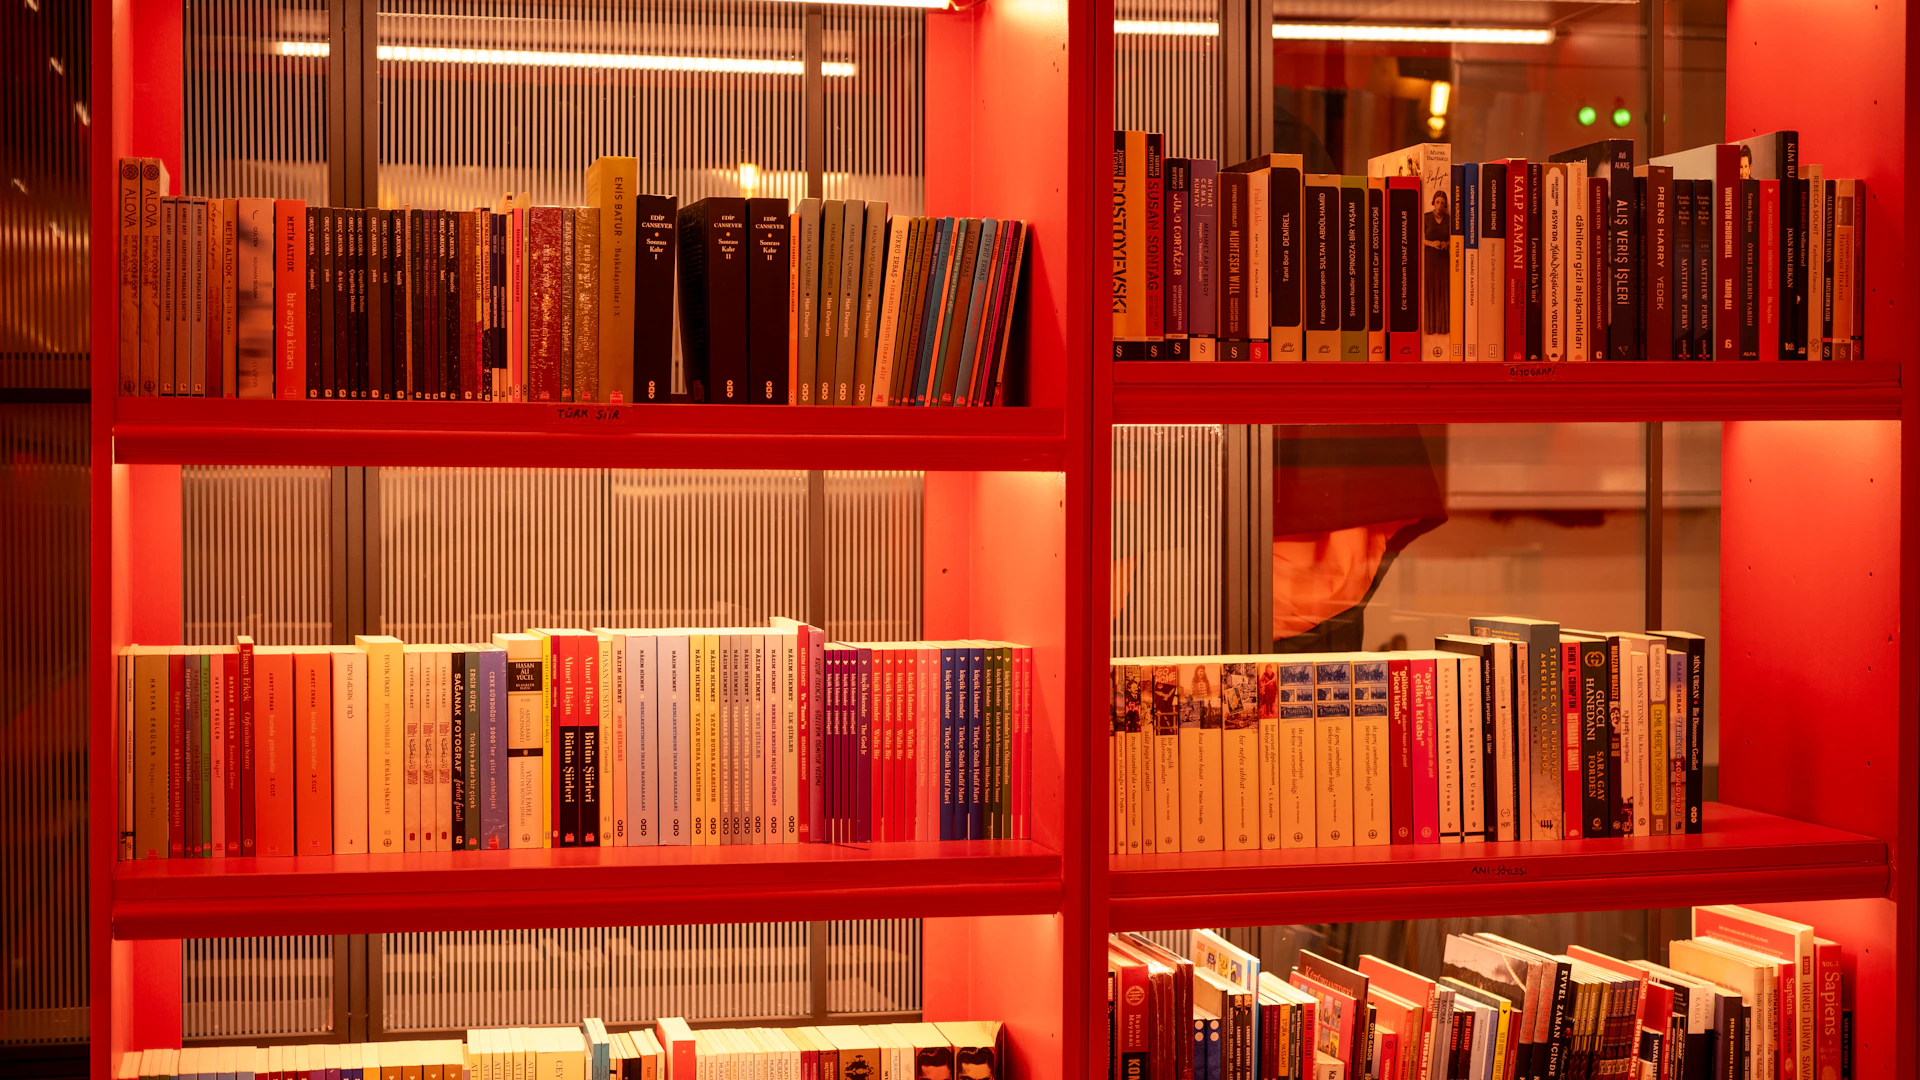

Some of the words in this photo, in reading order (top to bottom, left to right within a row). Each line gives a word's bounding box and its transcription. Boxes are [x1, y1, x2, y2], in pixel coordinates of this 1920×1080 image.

[615, 177, 625, 200] ENİS
[1514, 176, 1523, 210] KALP
[124, 189, 136, 228] ALOVA
[145, 189, 157, 228] ALOVA
[614, 204, 622, 236] BATUR
[1147, 181, 1159, 231] SUSAN
[1318, 193, 1326, 240] ABDÜLHAMİD
[1615, 200, 1628, 225] ALIŞ
[287, 216, 295, 241] METİN
[893, 230, 902, 253] ŞÜKRÜ
[1514, 215, 1523, 269] ZAMANI
[1576, 215, 1584, 260] dâhilerin
[1147, 235, 1159, 290] SONTAG
[1173, 226, 1183, 275] CORTÁZAR
[1228, 230, 1239, 273] MUHTEŞEM
[1615, 231, 1629, 263] VERİŞ
[613, 248, 621, 303] Başkalaşımlar
[890, 256, 899, 277] ERBAŞ
[1574, 263, 1584, 283] gizli
[1745, 266, 1753, 300] ŞEYLERİN
[287, 293, 296, 307] bir
[887, 284, 896, 313] insanın
[1230, 276, 1239, 295] WILL
[1615, 268, 1630, 305] İŞLERİ
[1724, 279, 1732, 297] TARIQ
[284, 310, 295, 336] acıya
[1574, 286, 1584, 349] alışkanlıkları
[287, 339, 296, 369] kiracı
[558, 408, 588, 418] TÜRK
[585, 655, 593, 685] Ahmet
[1156, 667, 1169, 675] GO
[1568, 647, 1576, 666] HENRY
[1693, 655, 1701, 673] MİNA
[243, 678, 251, 701] Erkek
[872, 672, 880, 692] küçük
[1156, 672, 1175, 683] HOME
[1413, 673, 1423, 707] çelikel
[1540, 654, 1548, 700] AMERİKA
[454, 673, 462, 715] SAĞANAK
[873, 694, 881, 721] İskender
[1586, 678, 1595, 741] HANEDANI
[1596, 690, 1605, 727] GUCCI
[454, 720, 462, 771] FOTOĞRAF
[565, 732, 574, 763] Bütün
[585, 732, 594, 764] Bütün
[1550, 730, 1558, 780] RUHUYLA
[563, 766, 574, 802] Şiirleri
[583, 766, 594, 802] Şiirleri
[1588, 755, 1596, 797] FORDEN
[1558, 970, 1568, 1001] EVVEL
[1784, 978, 1794, 1015] Sapiens
[1694, 997, 1702, 1024] KARGA
[1821, 971, 1839, 1035] Sapiens
[1553, 1004, 1563, 1040] ZAMAN
